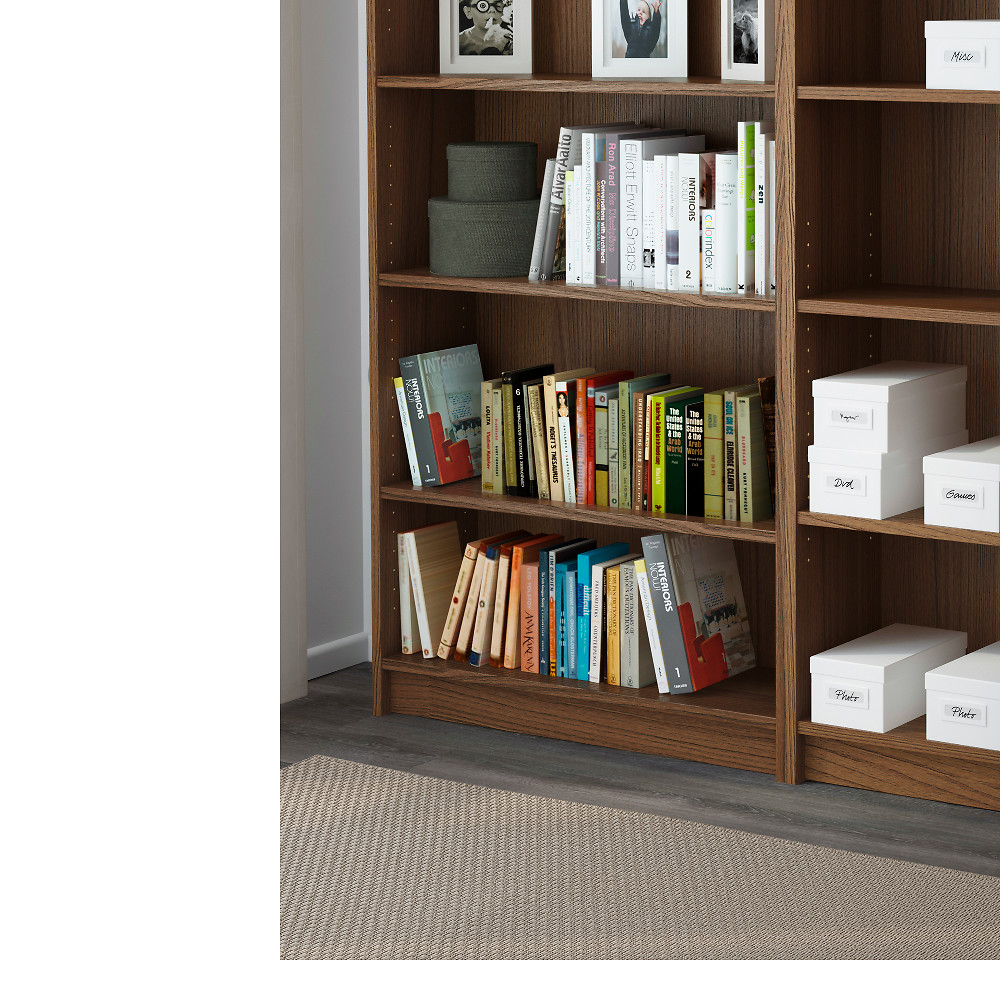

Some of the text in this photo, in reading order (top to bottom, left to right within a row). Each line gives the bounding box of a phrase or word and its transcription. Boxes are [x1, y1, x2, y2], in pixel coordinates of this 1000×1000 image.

[950, 50, 974, 63] Misc
[688, 176, 696, 222] INTERIORS
[622, 142, 639, 272] Elliott Erwitt Snaps
[704, 214, 717, 270] colorindex
[685, 269, 692, 280] 2
[411, 378, 425, 420] INTERIORS
[669, 407, 680, 415] The
[689, 410, 700, 418] The
[665, 415, 683, 423] United
[686, 417, 703, 426] United
[666, 422, 683, 431] States
[686, 425, 703, 433] States
[667, 438, 682, 446] Arab
[688, 440, 702, 448] Arab
[549, 426, 559, 484] ROGET'S THESAURUS
[666, 445, 683, 454] World
[686, 447, 703, 456] World
[726, 441, 735, 492] ELDRIDGE CLEAVER
[833, 477, 855, 490] Dvd
[945, 489, 976, 501] Games
[648, 562, 661, 591] NOW!
[656, 560, 674, 613] INTERIORS
[583, 584, 591, 616] difficult
[674, 667, 681, 678] 1
